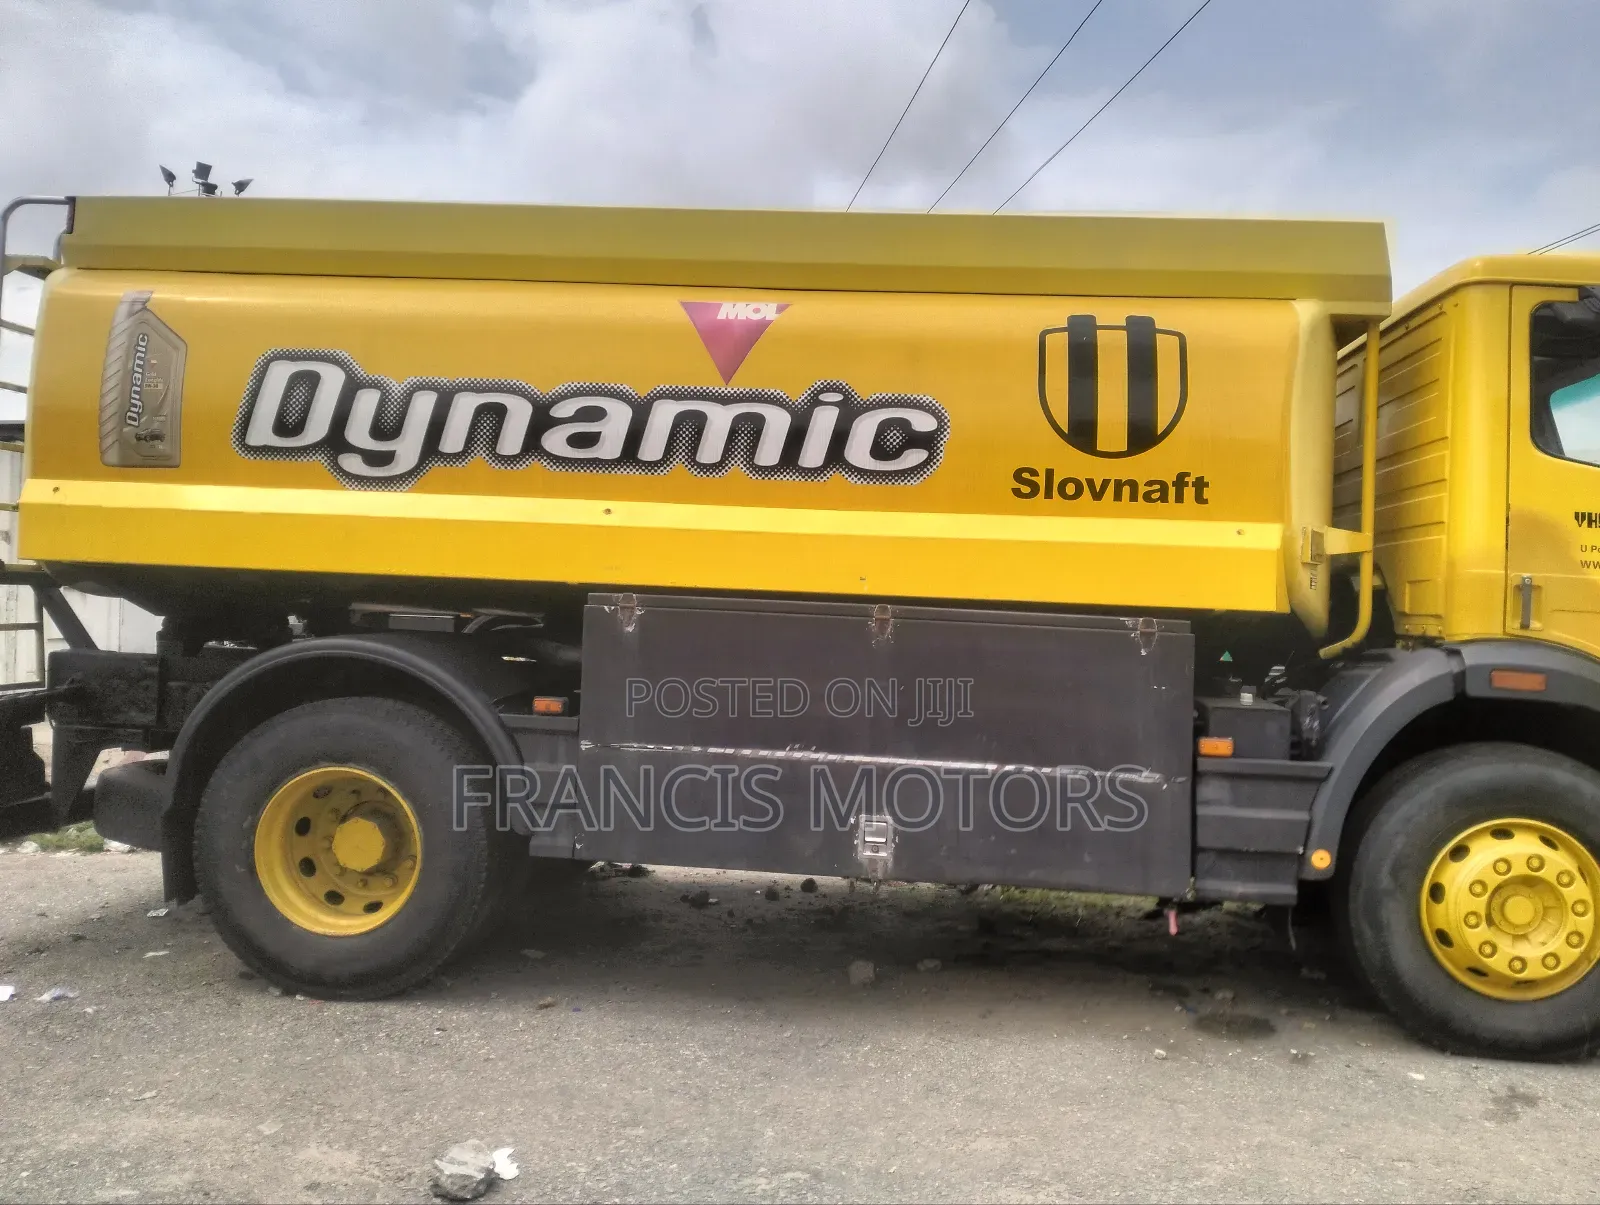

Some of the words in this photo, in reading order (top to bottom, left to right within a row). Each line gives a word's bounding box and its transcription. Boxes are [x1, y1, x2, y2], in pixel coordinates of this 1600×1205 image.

[717, 303, 779, 320] MOL
[126, 334, 148, 427] Dynamic
[245, 360, 938, 477] Dynamic
[1011, 466, 1209, 504] Slovnaft
[1574, 511, 1600, 528] VH
